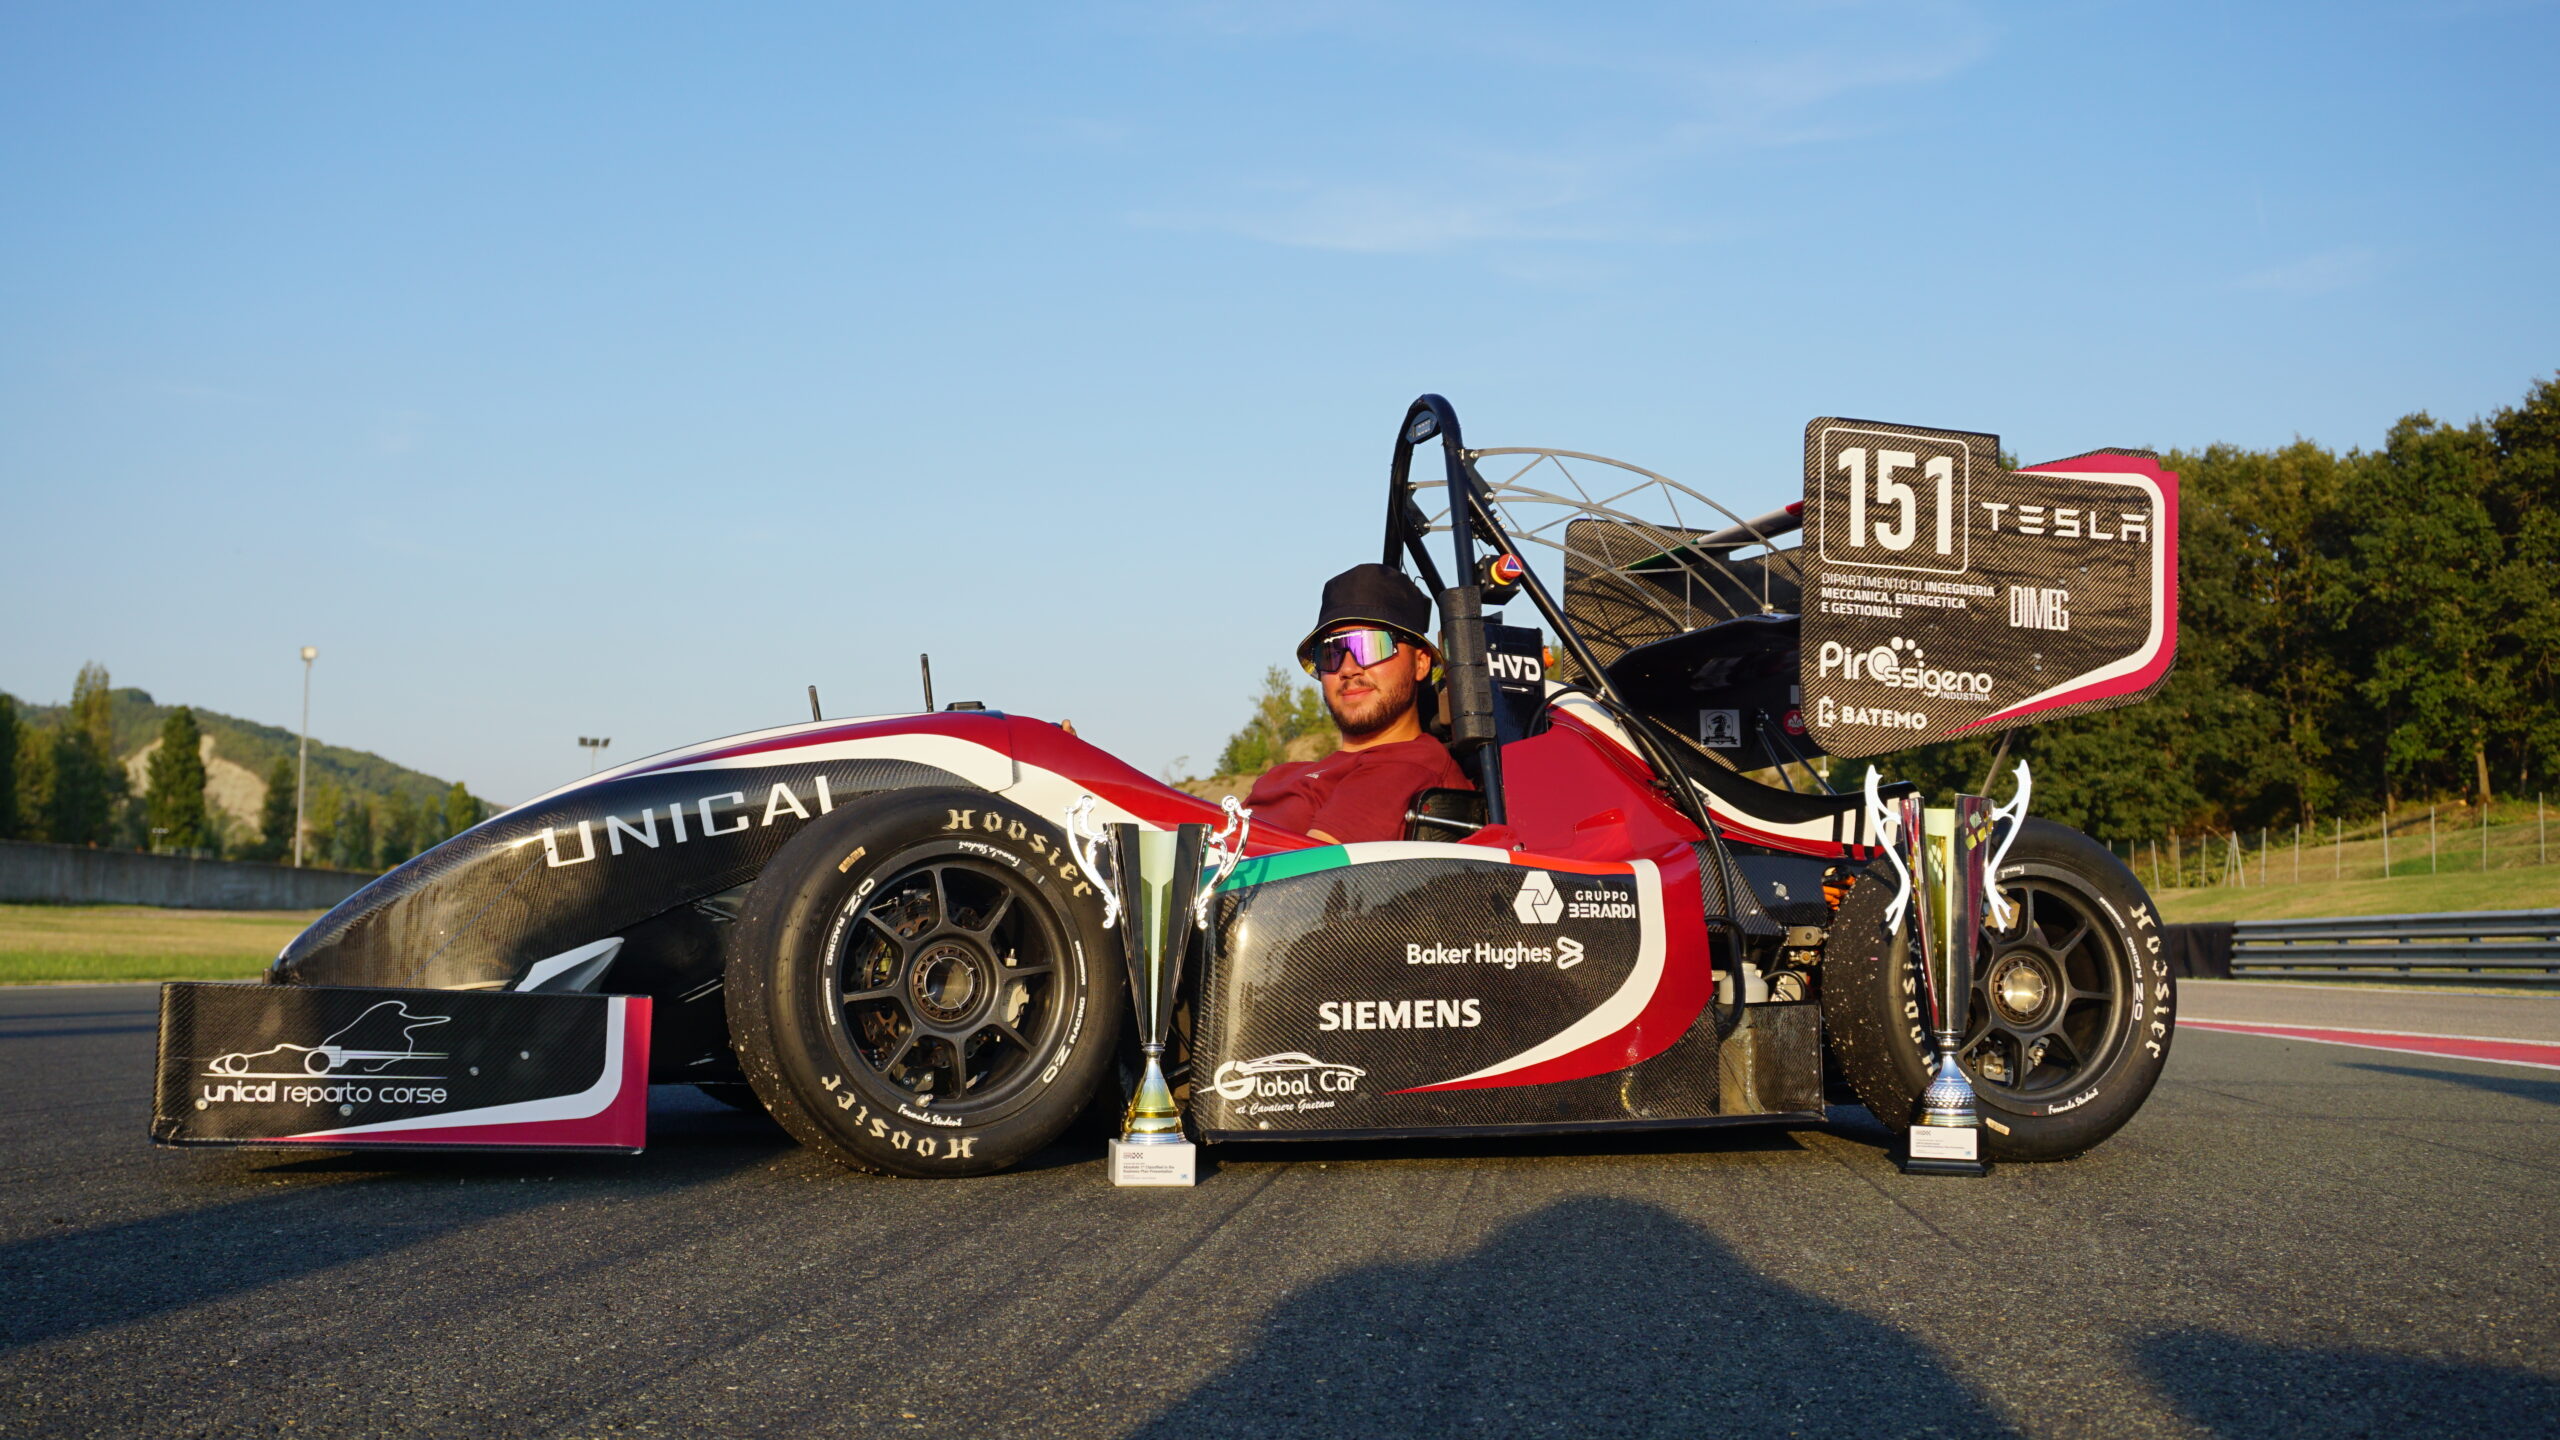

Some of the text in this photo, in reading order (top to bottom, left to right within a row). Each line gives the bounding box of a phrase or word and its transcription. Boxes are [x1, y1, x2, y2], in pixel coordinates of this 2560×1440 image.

[1838, 447, 1953, 555] 151
[1981, 501, 2147, 543] TESLA
[1821, 572, 1995, 598] DIPARTIMENTO DI INGEGNERIA
[1821, 587, 1967, 610] MECCANICA, ENERGETICA
[1821, 602, 1903, 619] E GESTIONALE
[2010, 585, 2069, 632] DIMEG
[1486, 652, 1541, 682] HVD
[1940, 691, 1991, 702] INDUSTRIA
[1842, 705, 1928, 730] BATEMO
[1575, 890, 1629, 902] GRUPPO
[1568, 903, 1636, 919] BERARDI
[826, 917, 846, 966] RACING
[1406, 941, 1552, 970] Baker Hughes
[1069, 996, 1086, 1044] RACING
[1318, 998, 1482, 1031] SIEMENS
[203, 1079, 448, 1108] unical reparto corse
[1213, 1060, 1358, 1101] Global Car
[1249, 1102, 1294, 1116] Cavaliere
[1297, 1099, 1336, 1114] Gaetano
